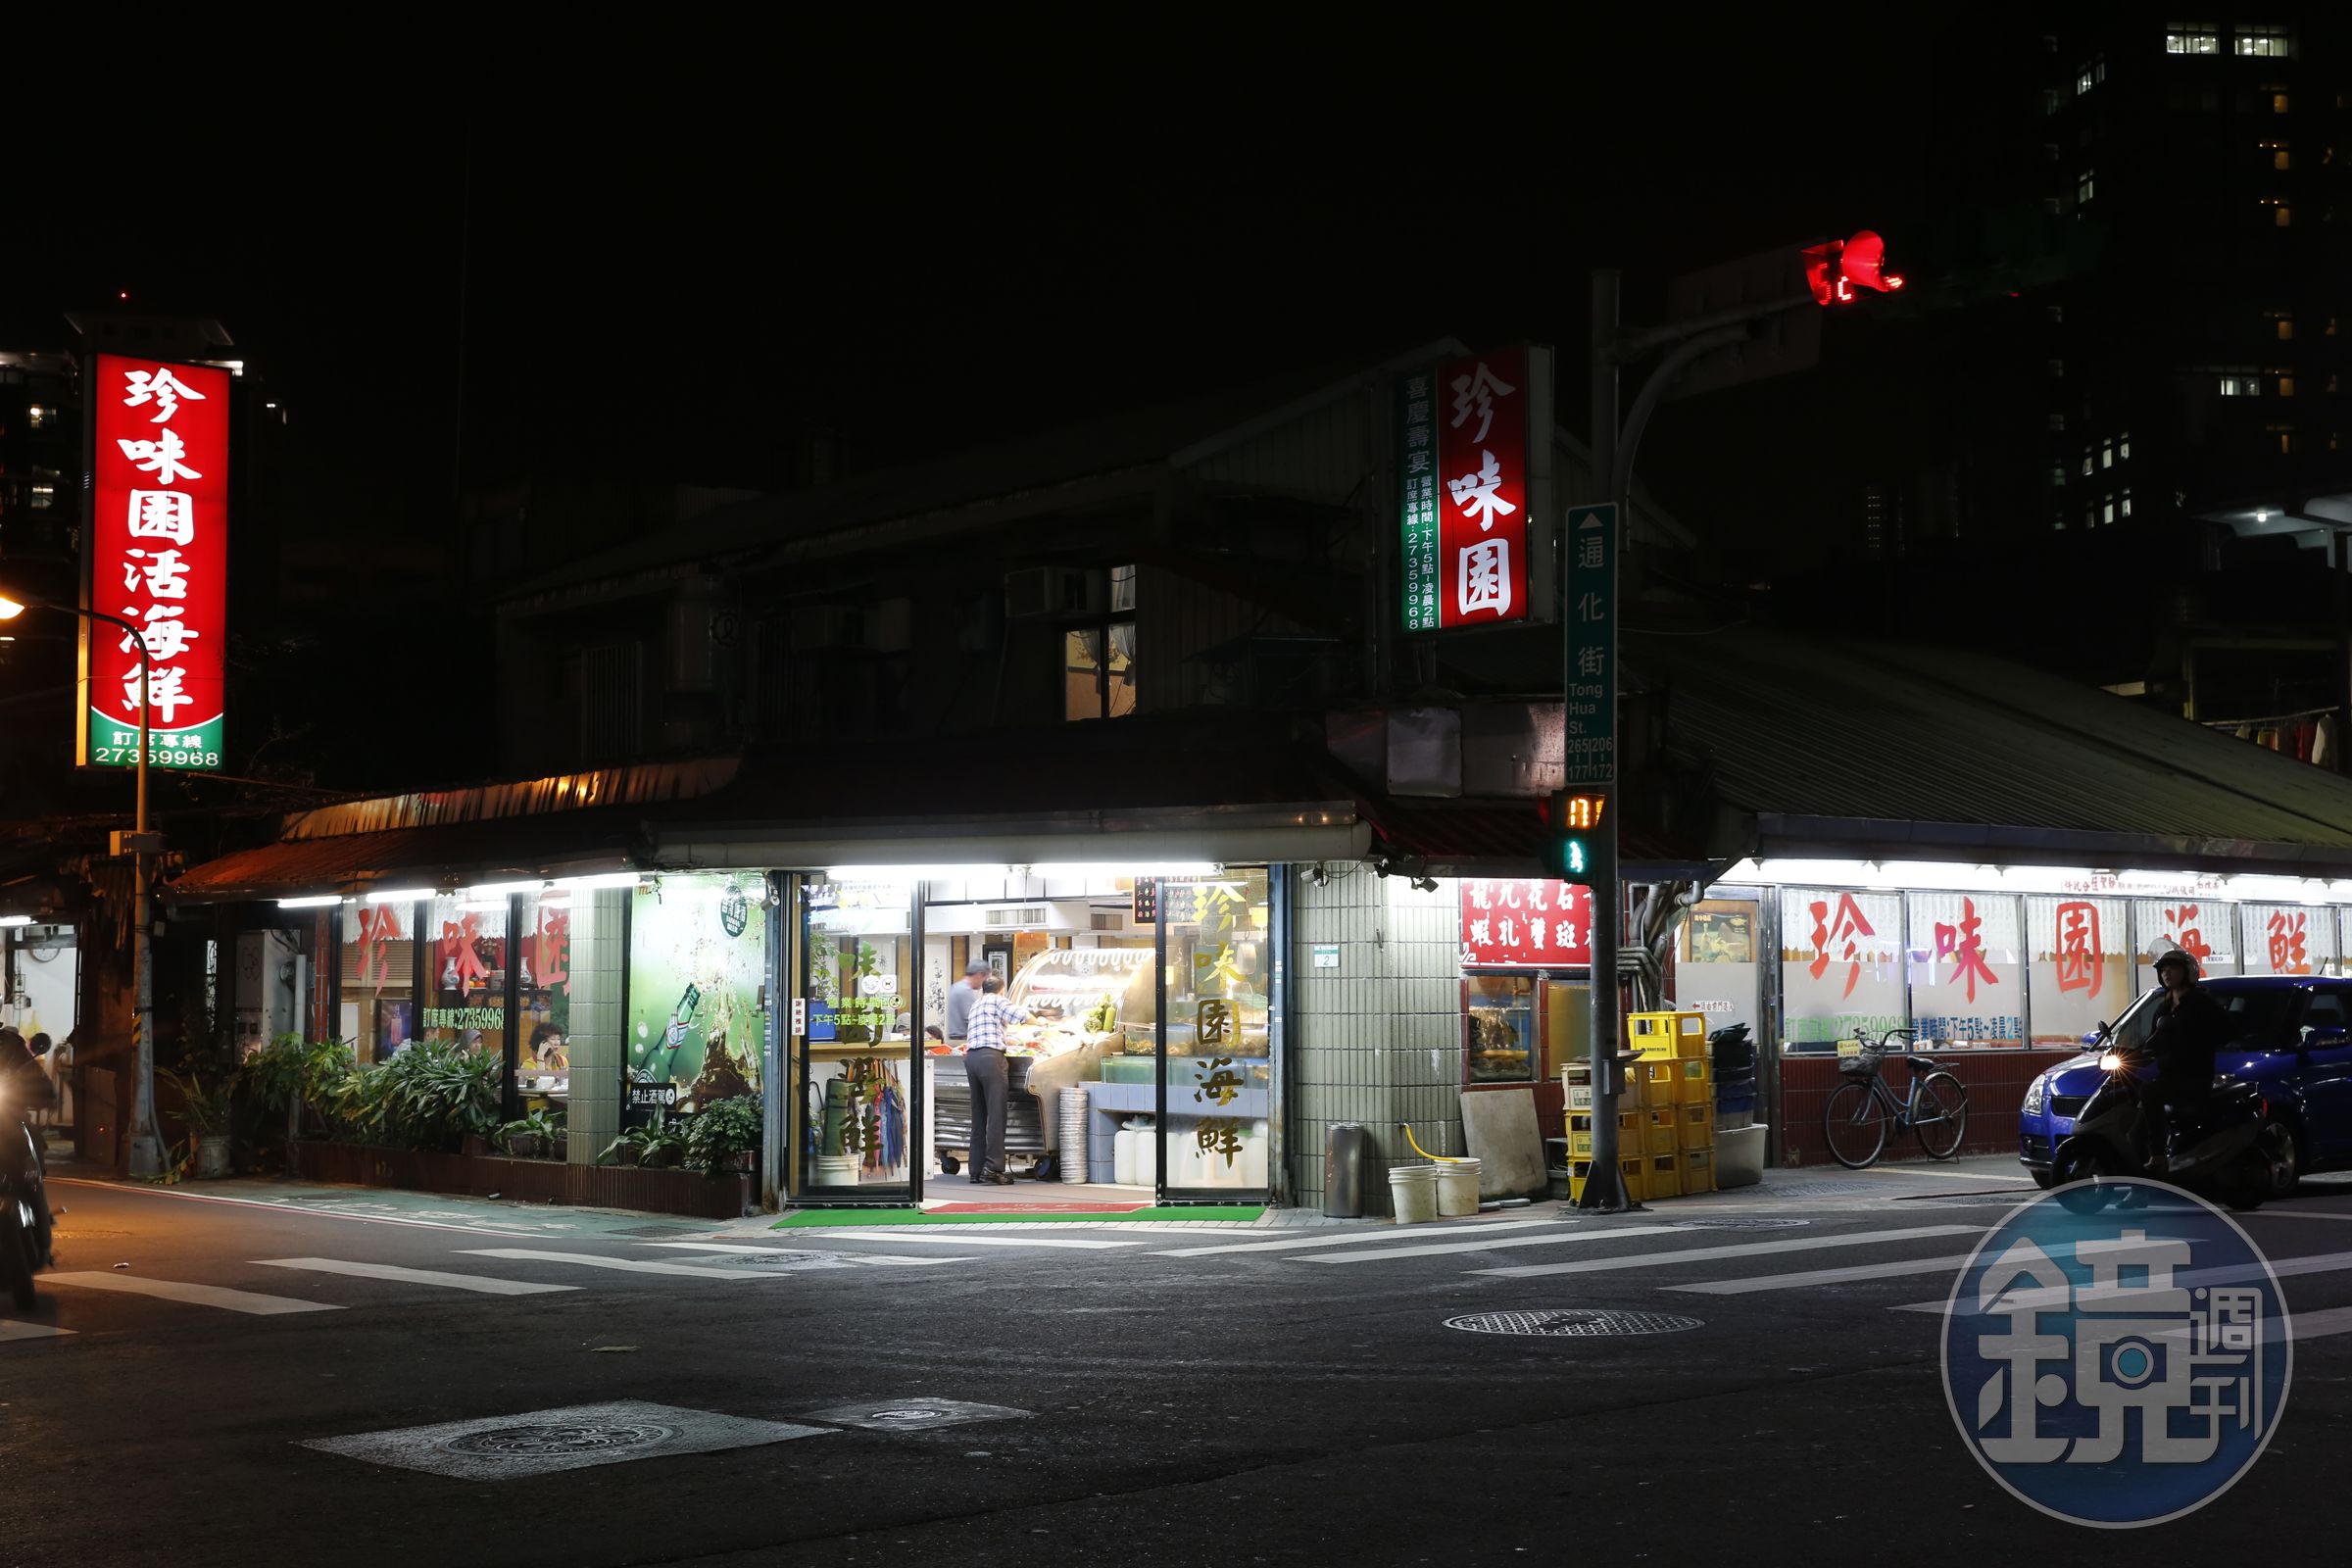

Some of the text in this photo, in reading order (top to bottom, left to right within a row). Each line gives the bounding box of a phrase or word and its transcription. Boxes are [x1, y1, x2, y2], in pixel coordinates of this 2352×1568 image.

[1405, 376, 1430, 473] 喜慶壽宴
[1446, 362, 1517, 617] 珍味園
[117, 367, 207, 723] 珍味園活海鮮
[1578, 536, 1605, 677] 通化街
[1568, 683, 1603, 698] Tong
[1569, 702, 1596, 715] Hua
[1569, 720, 1588, 735] St.
[1568, 738, 1589, 754] 265
[1592, 737, 1613, 753] 206
[95, 747, 220, 766] 27359968
[1569, 765, 1588, 780] 177
[1592, 762, 1613, 779] 172
[1323, 955, 1330, 965] 2
[1192, 882, 1247, 1169] 珍味園海鮮
[632, 1088, 665, 1104] 禁止酒駕
